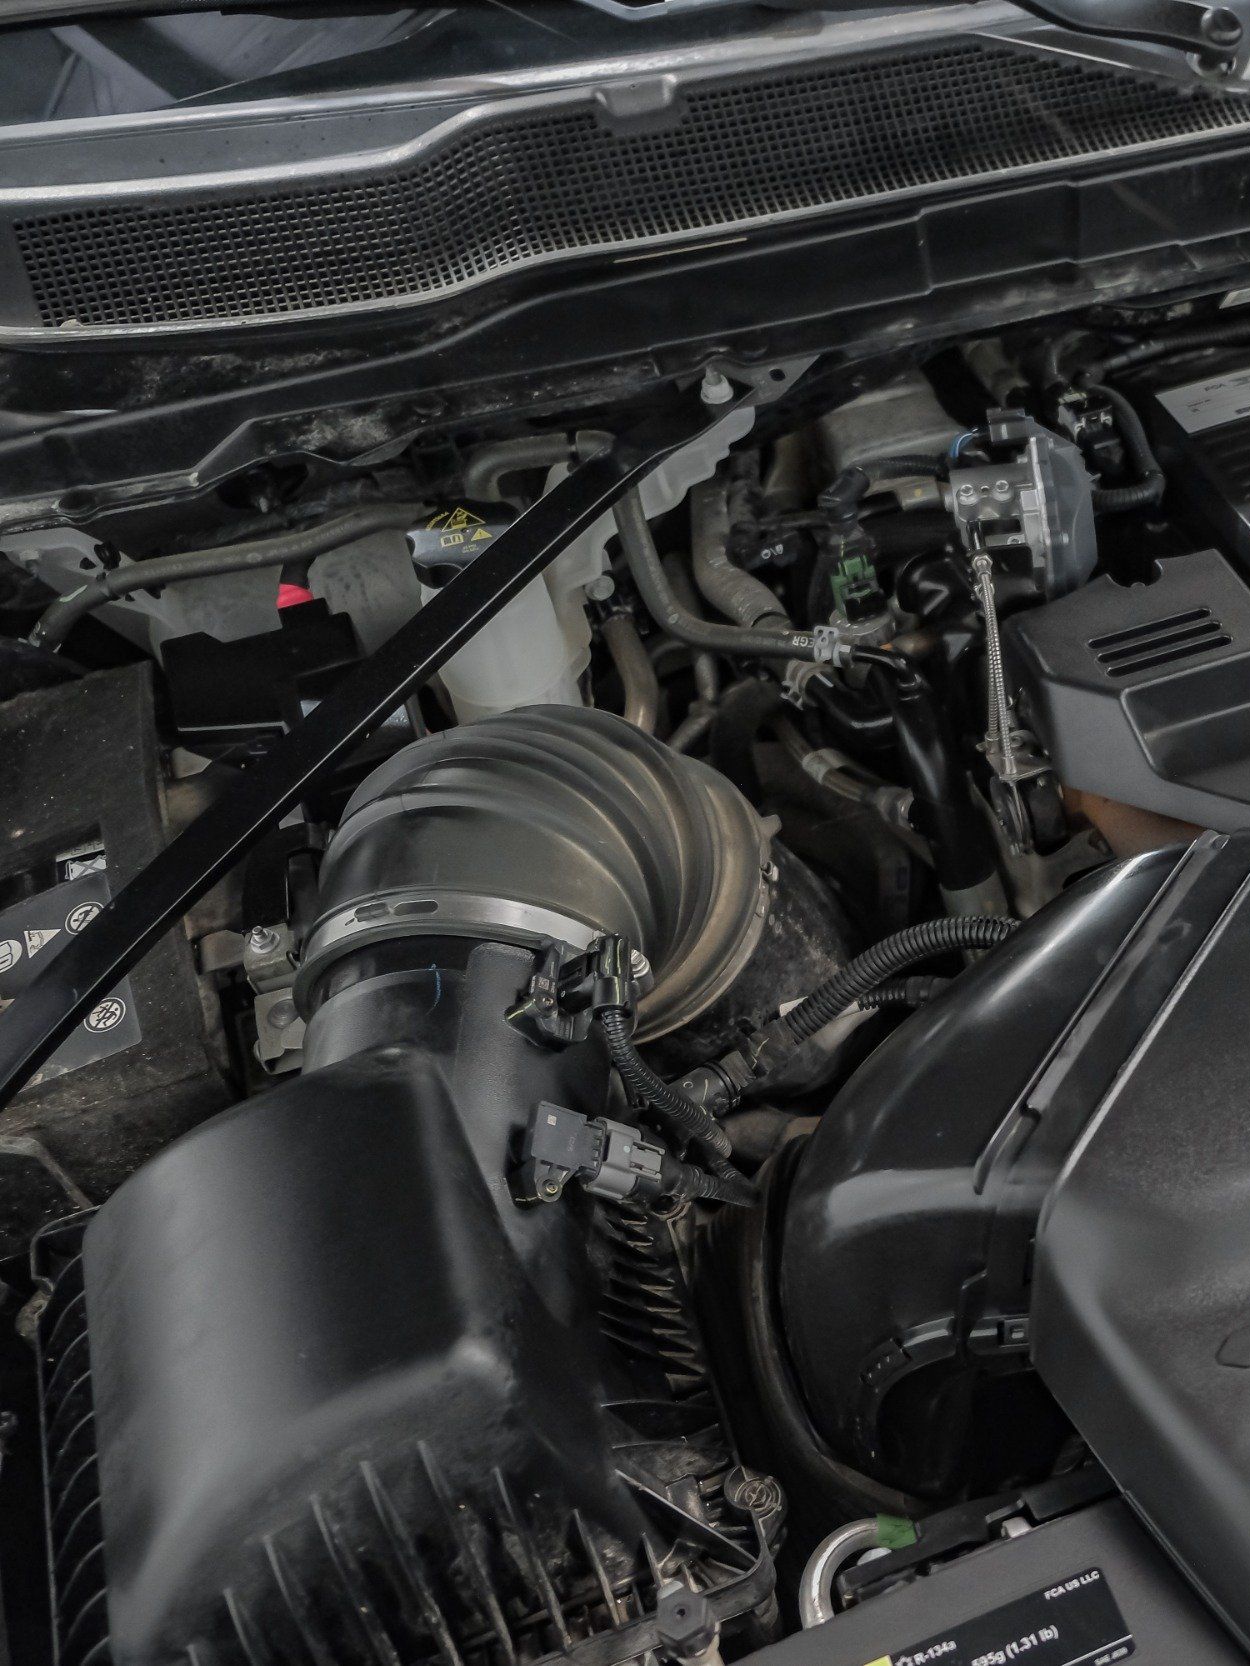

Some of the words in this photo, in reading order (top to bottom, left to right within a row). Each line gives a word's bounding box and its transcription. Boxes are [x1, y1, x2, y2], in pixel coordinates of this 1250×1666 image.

[1044, 1586, 1066, 1599] FCA
[1080, 1570, 1100, 1585] LLC
[913, 1640, 957, 1666] R-134a
[1005, 1633, 1039, 1660] (1.31
[1038, 1624, 1059, 1642] lb)
